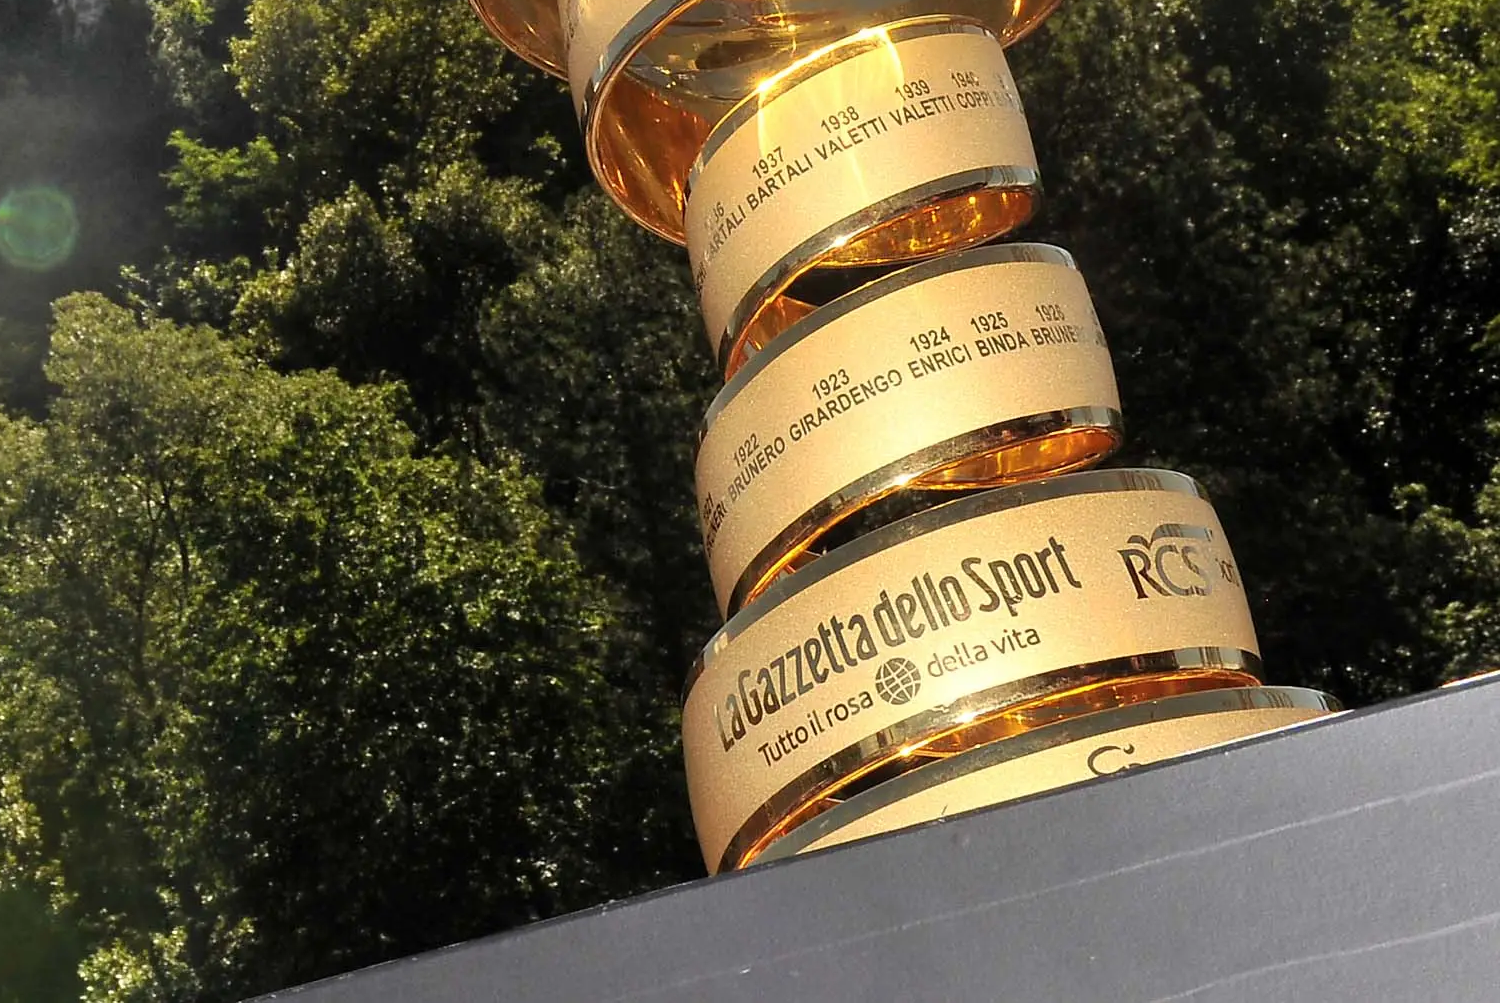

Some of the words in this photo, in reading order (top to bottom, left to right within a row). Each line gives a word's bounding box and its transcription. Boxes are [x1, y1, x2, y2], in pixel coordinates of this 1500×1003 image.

[704, 204, 747, 262] ARTALI
[746, 153, 813, 211] BARTALI
[814, 115, 888, 161] VALETTI
[889, 94, 955, 127] VALETTI
[956, 91, 995, 110] COPPI
[752, 146, 785, 179] 1937
[820, 105, 860, 134] 1938
[895, 79, 930, 101] 1939
[727, 436, 785, 502] BRUNERO
[788, 368, 903, 442] GIRARDENGO
[907, 343, 973, 379] ENRICI
[975, 331, 1030, 358] BINDA
[1030, 325, 1086, 347] BRUNE
[733, 432, 760, 468] 1922
[812, 368, 850, 401] 1923
[910, 326, 951, 353] 1924
[970, 311, 1009, 334] 1925
[1035, 304, 1065, 323] 1926
[961, 536, 1083, 617] Sport
[757, 725, 809, 767] Tutto
[807, 709, 825, 736] il
[825, 690, 874, 728] rosa
[927, 642, 989, 678] della
[991, 627, 1041, 655] vita
